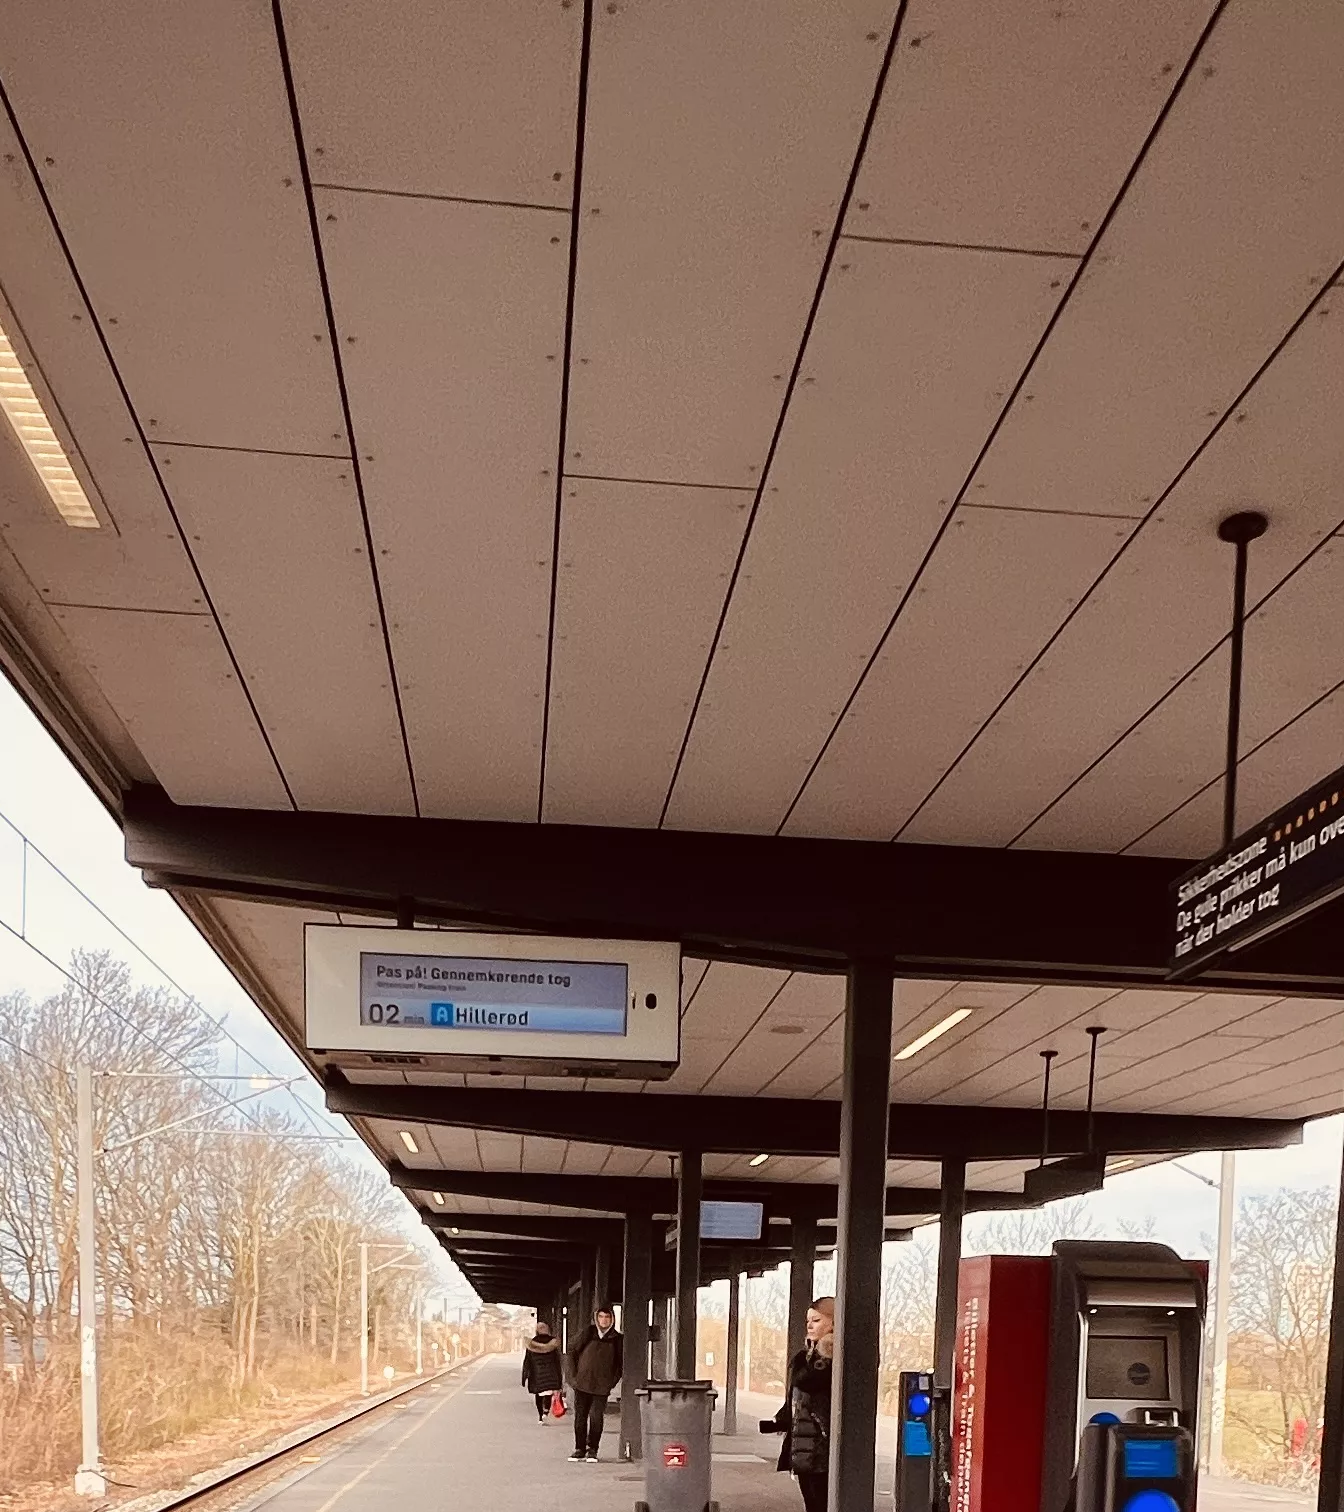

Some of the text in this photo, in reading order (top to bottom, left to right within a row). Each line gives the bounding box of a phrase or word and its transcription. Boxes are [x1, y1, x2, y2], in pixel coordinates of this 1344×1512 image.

[1176, 911, 1192, 932] De
[1194, 893, 1217, 923] gule
[1220, 866, 1263, 912] prikker
[1265, 846, 1286, 879] må
[1289, 834, 1316, 865] kun
[1177, 836, 1267, 907] Sikkerhedszone
[1175, 883, 1280, 958] når der holder tog
[376, 965, 571, 988] Pas på! Gennemkørende tog
[369, 1003, 529, 1026] 02 min A Hillerød
